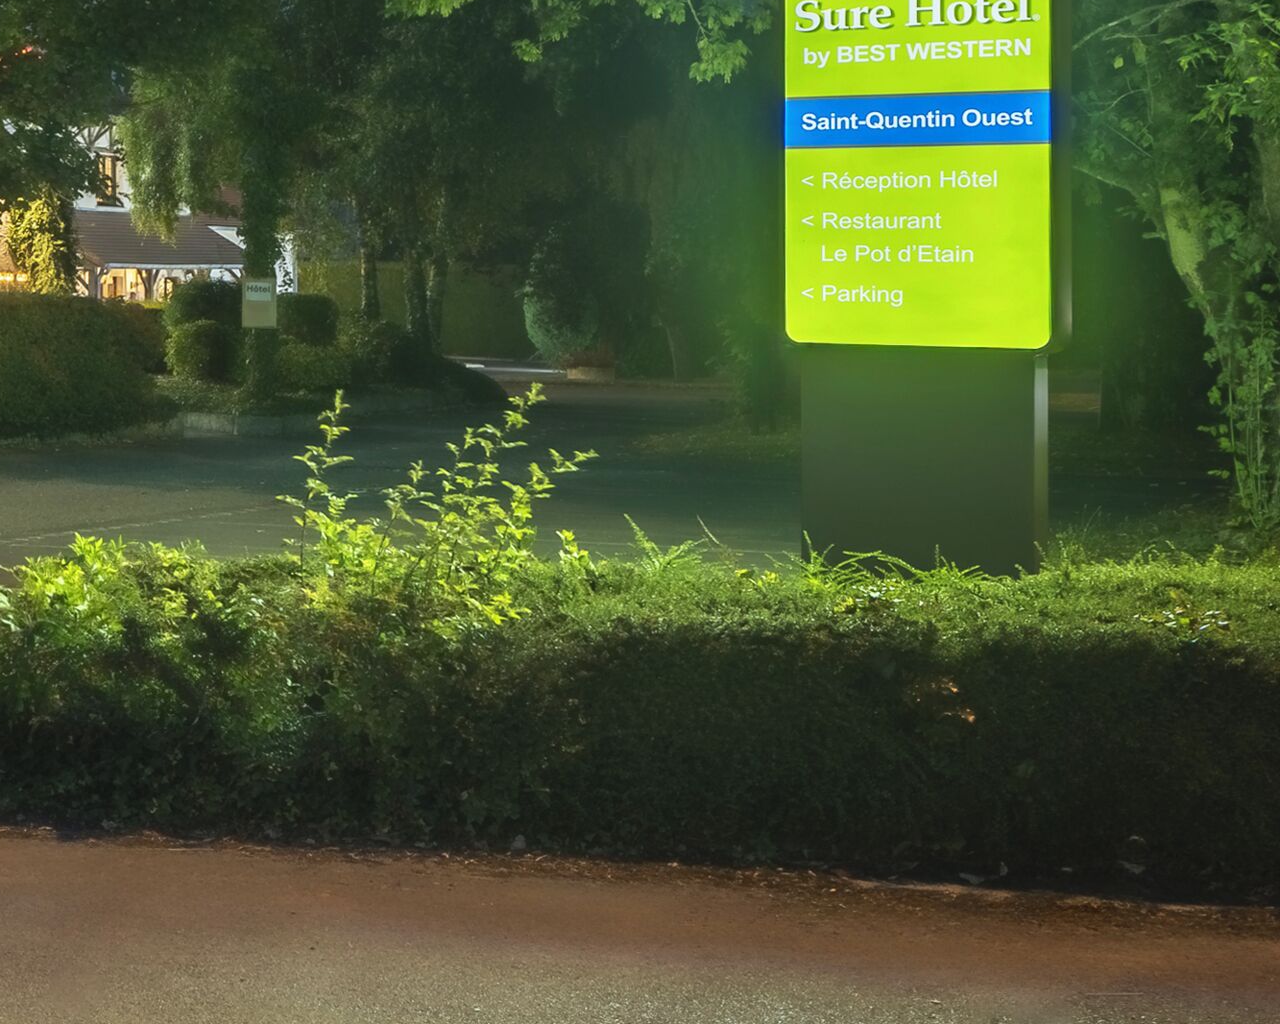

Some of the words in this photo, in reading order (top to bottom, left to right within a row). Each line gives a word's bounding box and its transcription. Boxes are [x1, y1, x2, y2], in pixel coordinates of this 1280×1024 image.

[794, 0, 892, 32] Sure
[803, 48, 830, 68] by
[837, 43, 900, 64] BEST
[906, 38, 1032, 60] WESTERN
[801, 110, 955, 130] Saint-Quentin
[962, 108, 1033, 127] Ouest
[821, 171, 931, 192] Réception
[939, 170, 998, 188] Hôtel
[821, 212, 942, 229] Restaurant
[821, 245, 847, 262] Le
[855, 245, 891, 262] Pot
[247, 284, 271, 293] Hôtel
[821, 285, 904, 307] Parking
